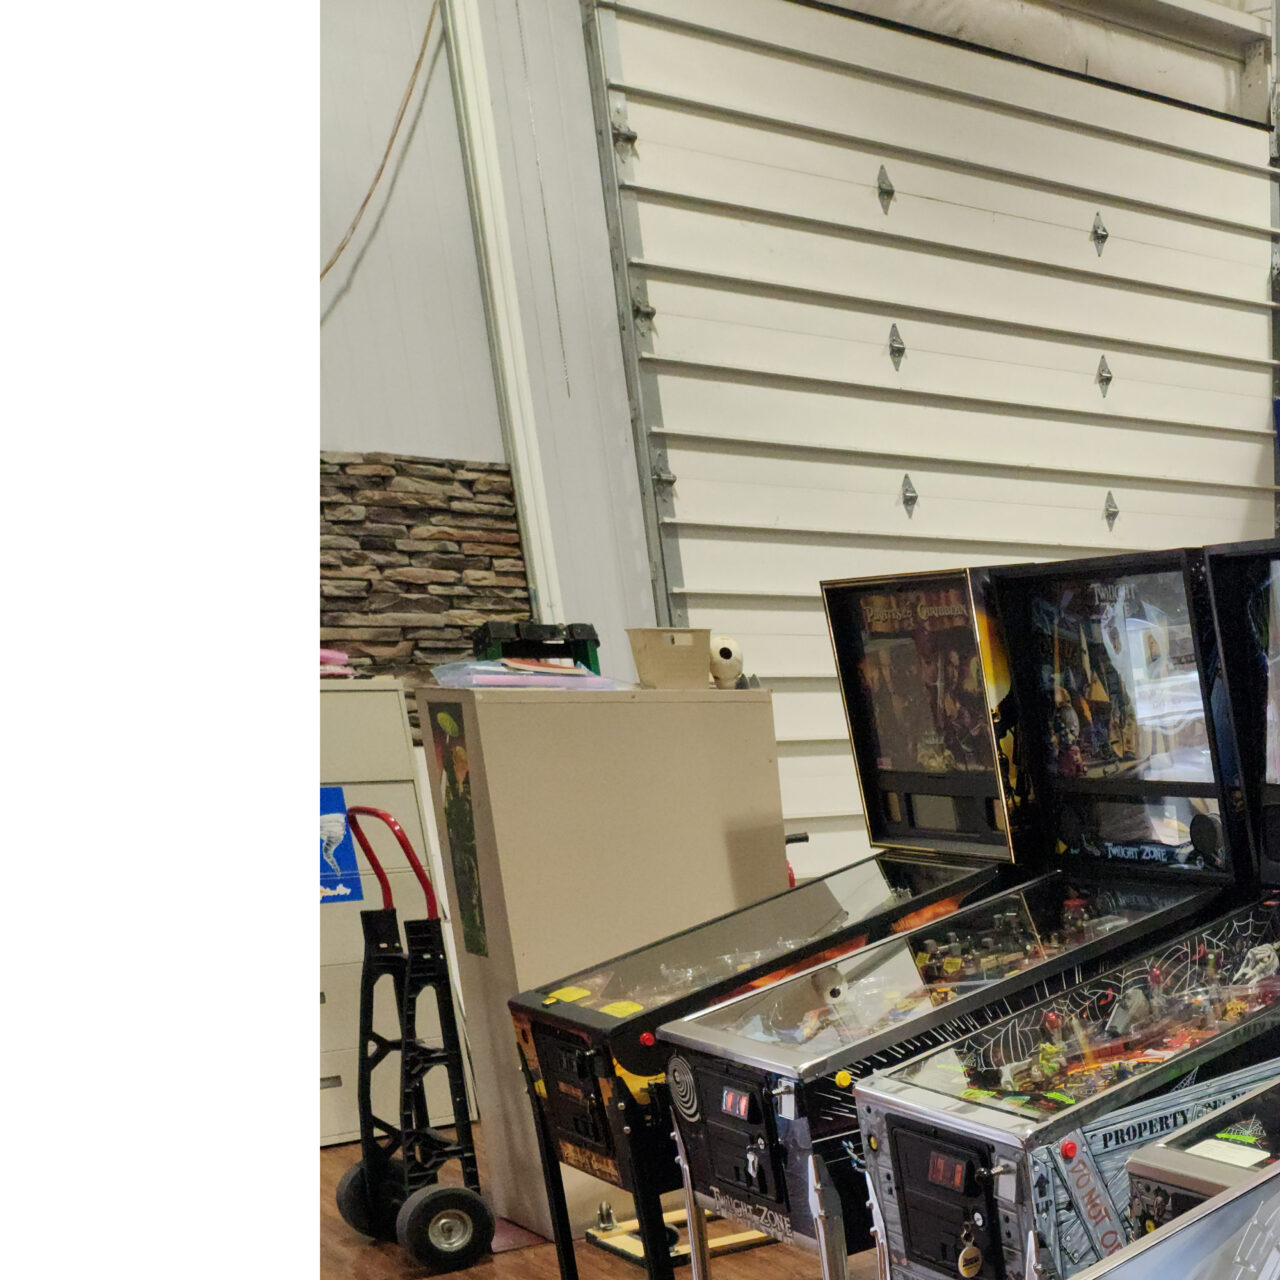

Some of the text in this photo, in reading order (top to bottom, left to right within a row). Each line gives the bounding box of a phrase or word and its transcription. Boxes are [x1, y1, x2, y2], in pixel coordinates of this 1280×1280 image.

[1140, 845, 1168, 862] ZONE
[1102, 1108, 1190, 1149] PROPERTY
[756, 1204, 793, 1237] ZONE
[1082, 1187, 1112, 1227] NOT
